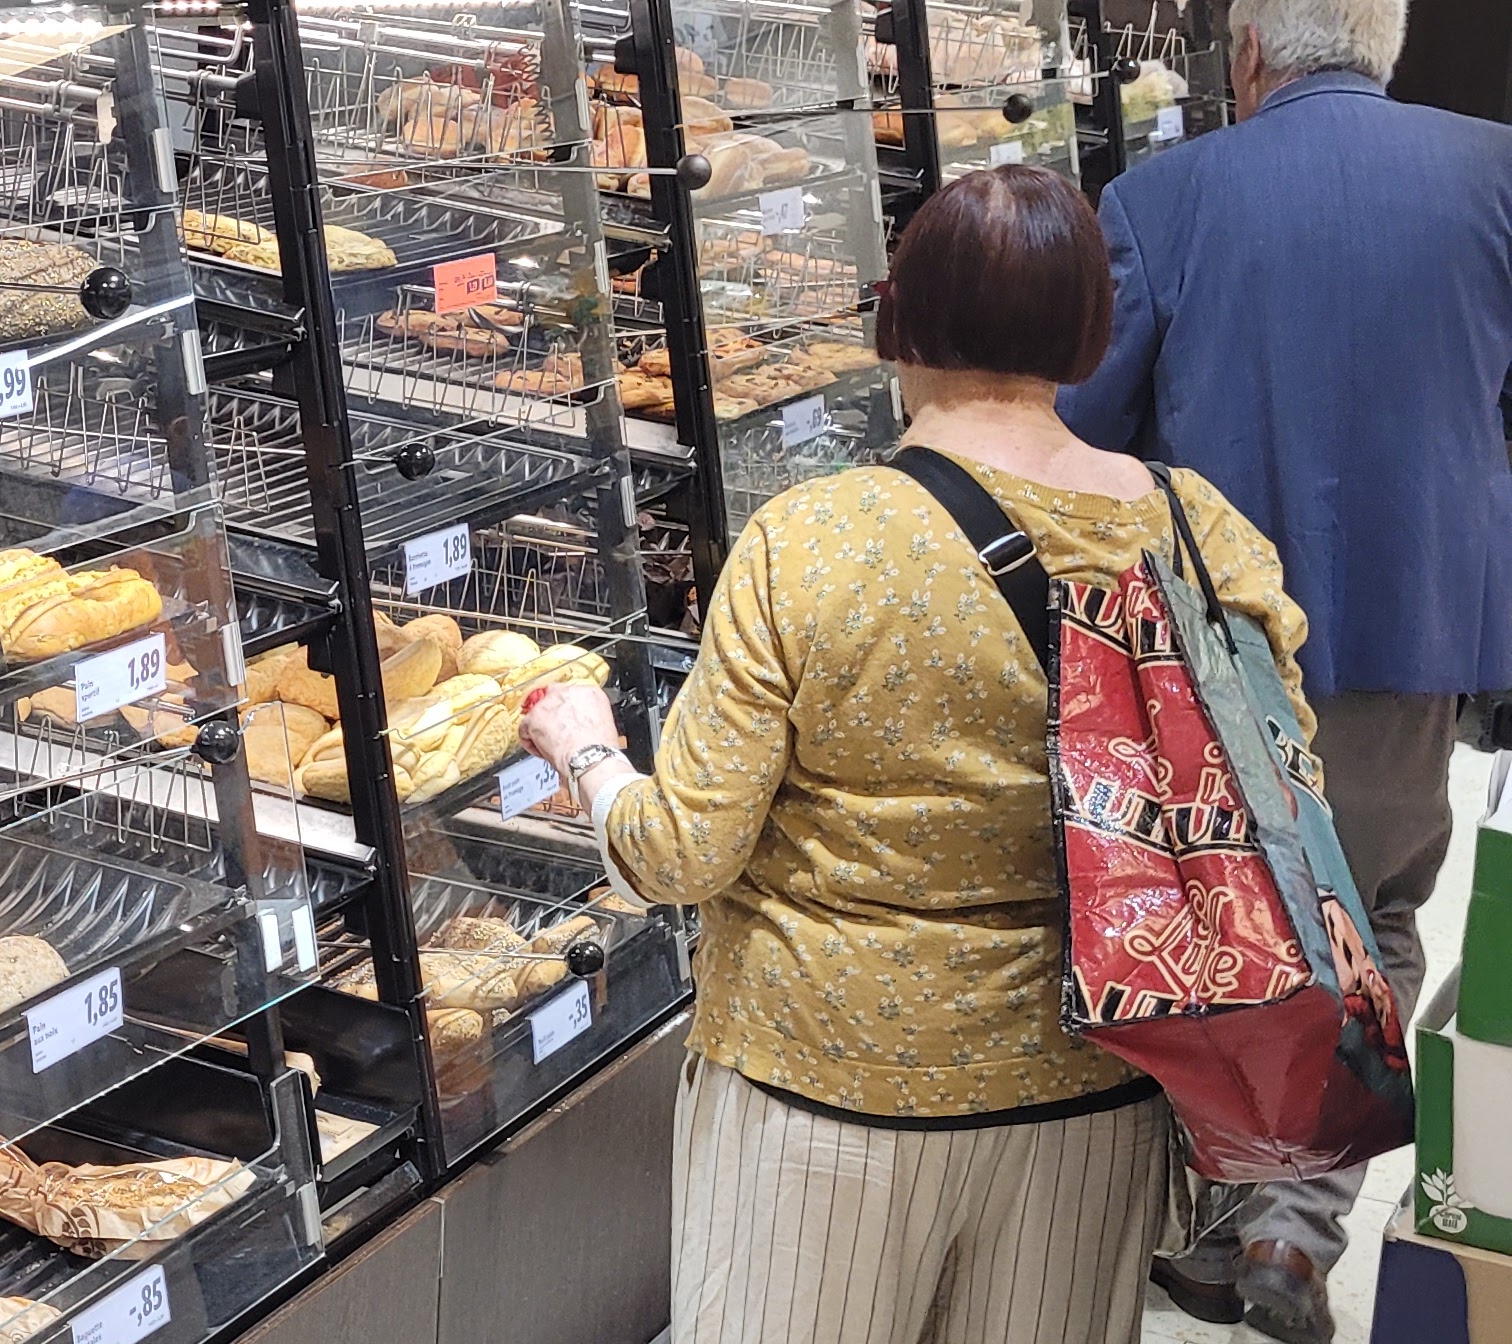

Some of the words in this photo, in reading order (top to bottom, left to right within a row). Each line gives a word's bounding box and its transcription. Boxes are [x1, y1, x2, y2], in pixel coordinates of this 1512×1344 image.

[443, 533, 467, 568] 1,89
[128, 648, 160, 690] 1,89
[84, 979, 118, 1026] 1,85
[568, 994, 588, 1029] -,35
[32, 1022, 46, 1035] Pain
[129, 1276, 163, 1327] -,85
[76, 1321, 103, 1344] Baguette
